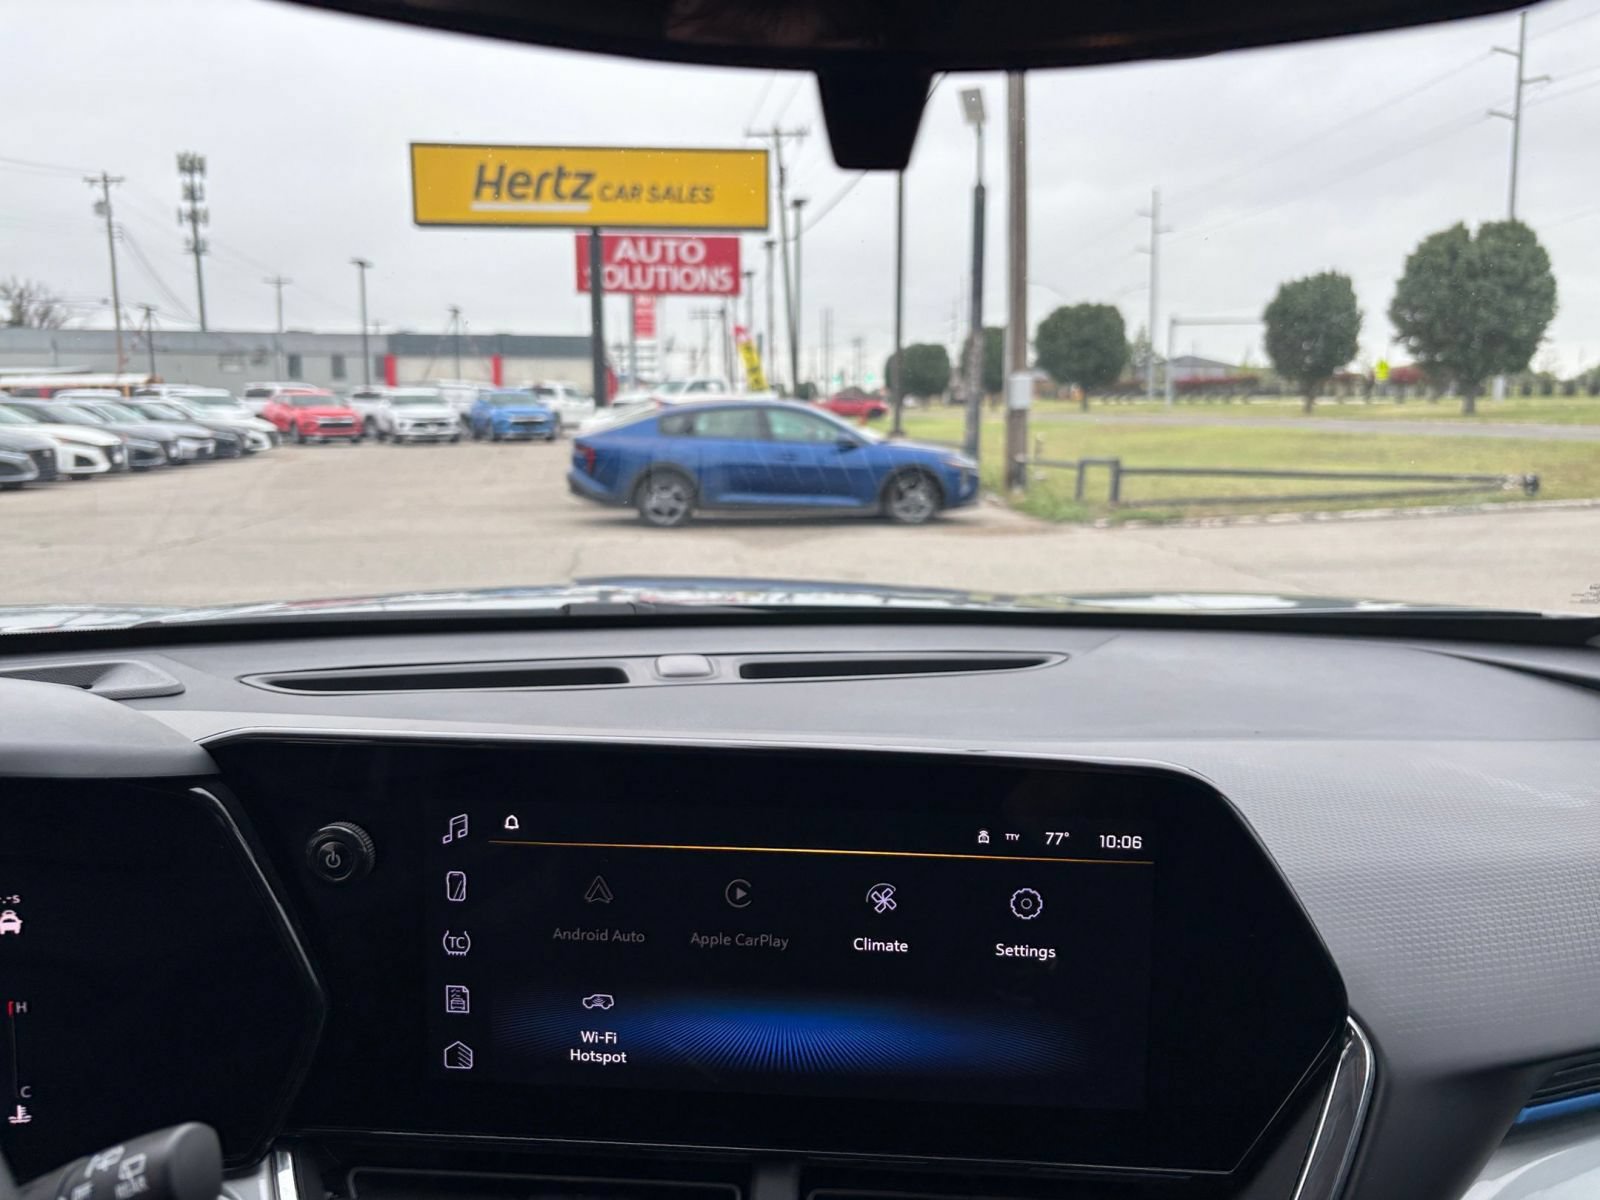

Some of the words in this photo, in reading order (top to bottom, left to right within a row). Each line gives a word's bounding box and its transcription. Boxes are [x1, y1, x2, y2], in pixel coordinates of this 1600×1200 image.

[472, 163, 596, 201] Hertz
[600, 182, 643, 203] CAR
[647, 185, 714, 204] SALES
[613, 238, 706, 264] AUTO
[1005, 833, 1020, 841] TTY
[1045, 832, 1070, 846] 77°
[1099, 834, 1142, 850] 10:06
[448, 935, 466, 949] TC
[552, 927, 609, 941] Android
[612, 928, 645, 943] Auto
[690, 932, 732, 949] Apple
[735, 933, 790, 951] CarPlay
[853, 937, 909, 953] Climate
[995, 943, 1056, 961] Settings
[16, 1002, 27, 1013] H
[580, 1030, 618, 1044] Wi-Fi
[570, 1048, 627, 1065] Hotspot
[21, 1086, 32, 1098] C
